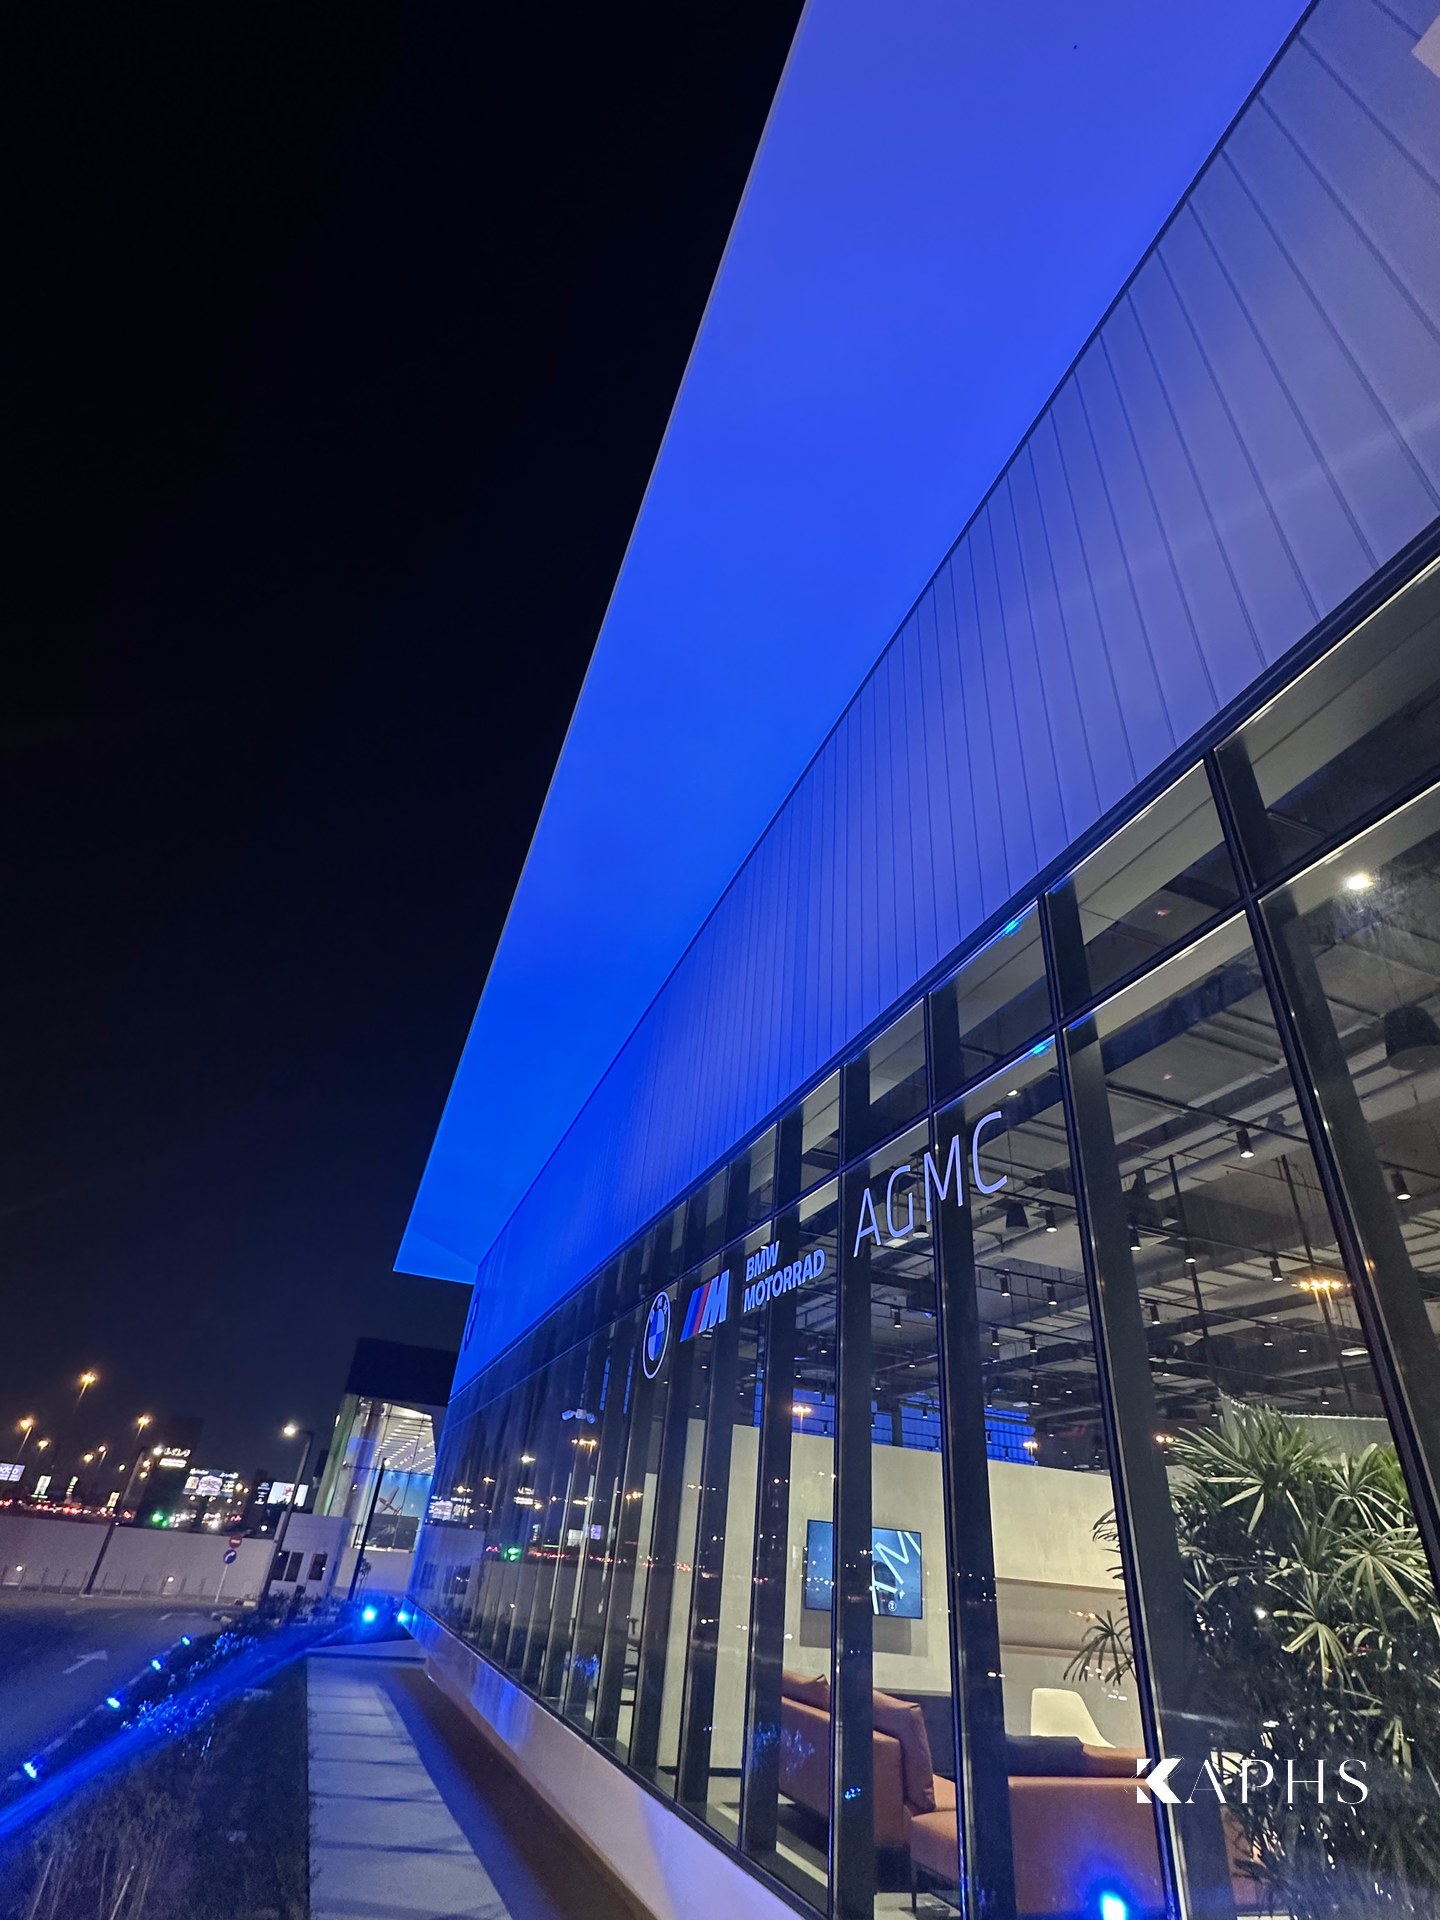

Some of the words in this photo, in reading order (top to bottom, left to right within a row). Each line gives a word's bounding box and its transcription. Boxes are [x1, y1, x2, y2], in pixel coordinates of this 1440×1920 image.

[853, 1110, 1008, 1258] AGMC
[743, 1249, 826, 1313] MOTORRAD
[745, 1240, 780, 1282] BMW
